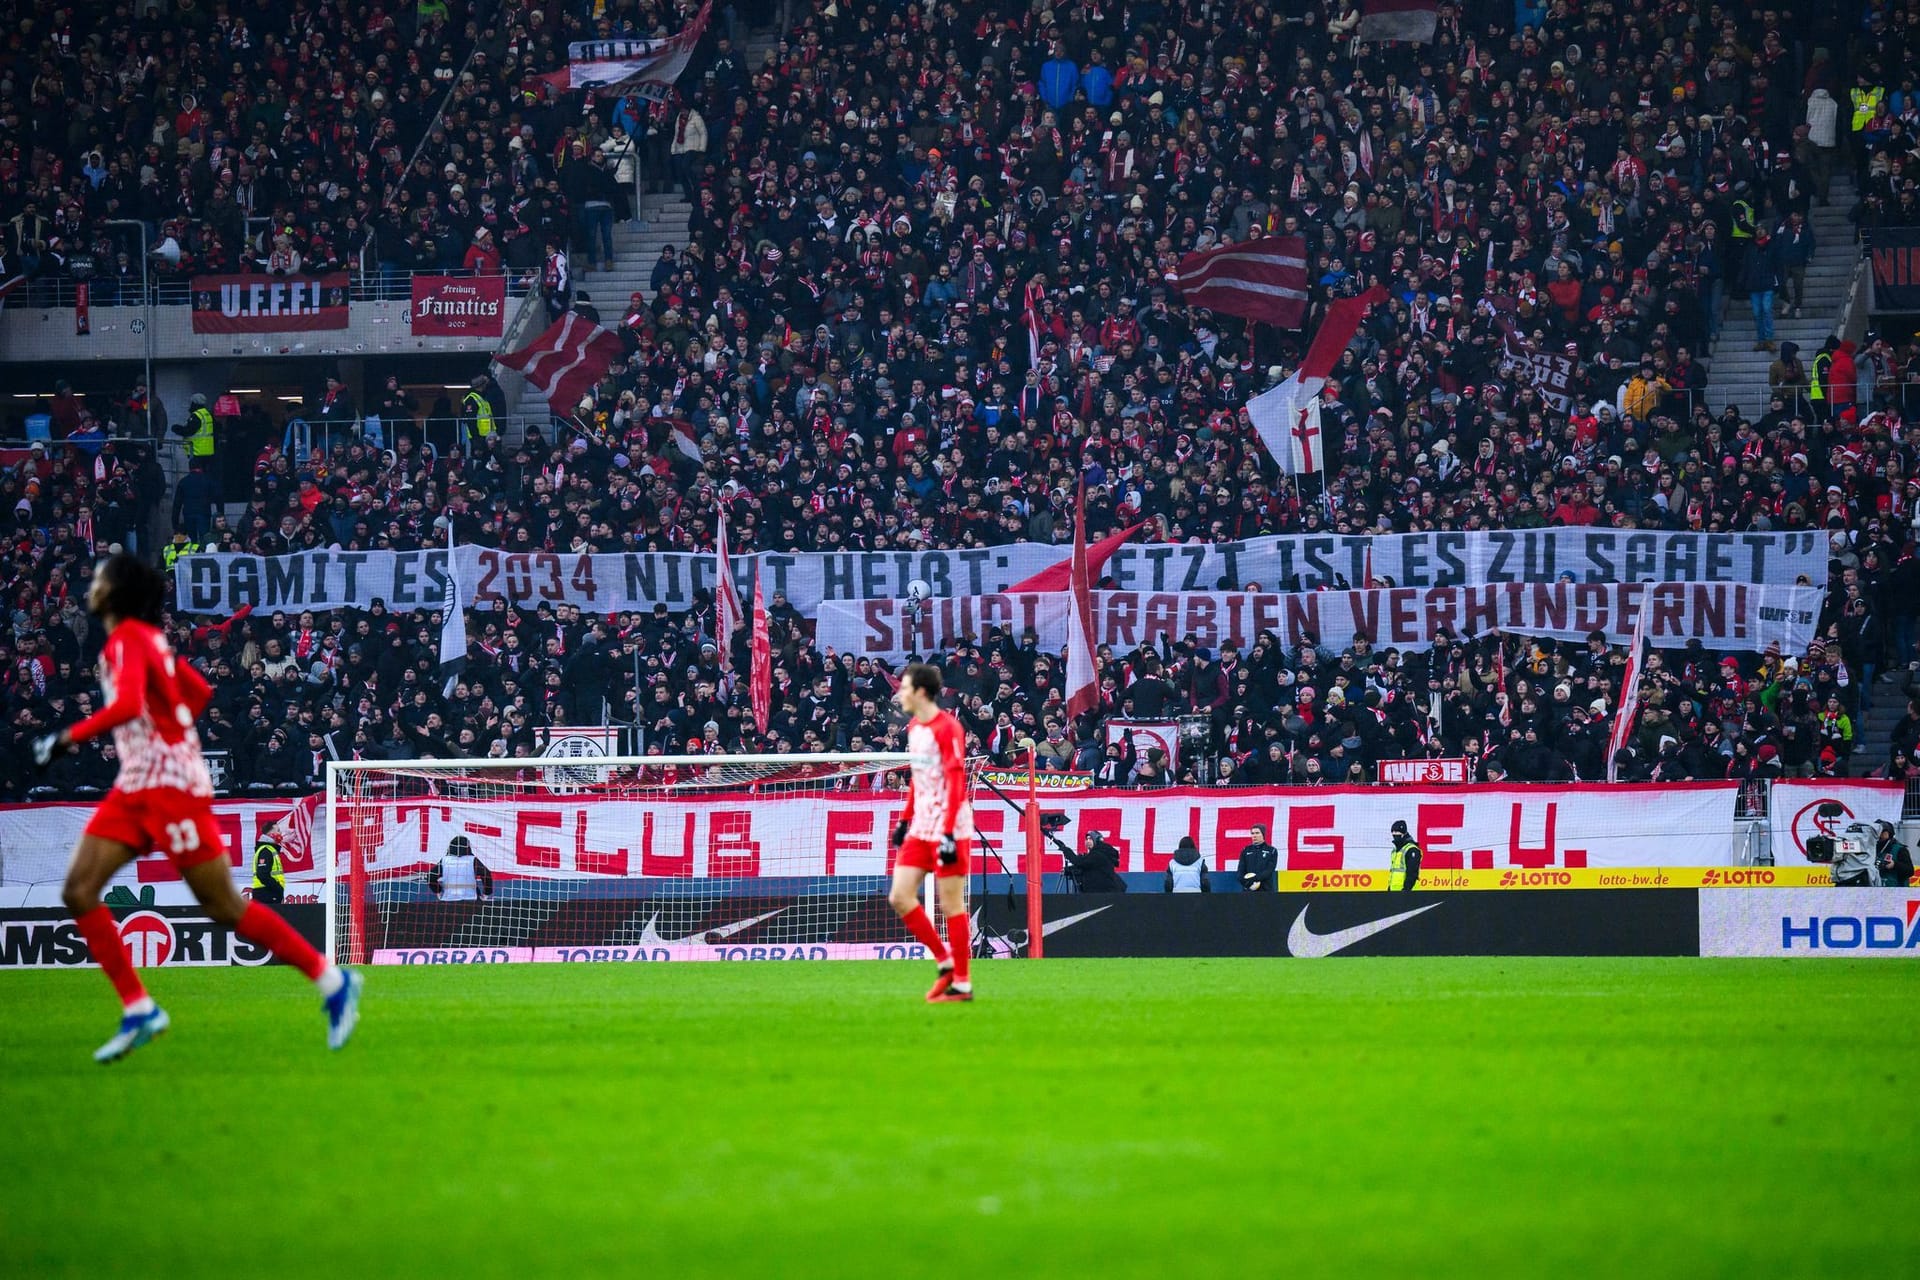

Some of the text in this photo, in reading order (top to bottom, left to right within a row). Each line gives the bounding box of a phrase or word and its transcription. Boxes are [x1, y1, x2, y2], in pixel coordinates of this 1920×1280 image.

[442, 284, 476, 295] Freiburg
[191, 553, 367, 607] DAMIT
[393, 551, 448, 602] ES
[477, 551, 598, 601] 2034
[1108, 542, 1247, 592] ETZT
[1276, 535, 1373, 590] IST
[1402, 532, 1466, 587] ES
[1487, 532, 1556, 584] ZU
[864, 594, 1040, 652] SAUDI
[1349, 582, 1746, 644] VERHINDERN!
[1323, 873, 1372, 887] LOTTO
[1521, 871, 1572, 886] LOTTO
[1599, 873, 1669, 886] lotto-bw.de
[1723, 870, 1776, 885] LOTTO
[396, 945, 926, 965] JOBRAD JOBRAD JOBRAD JOB
